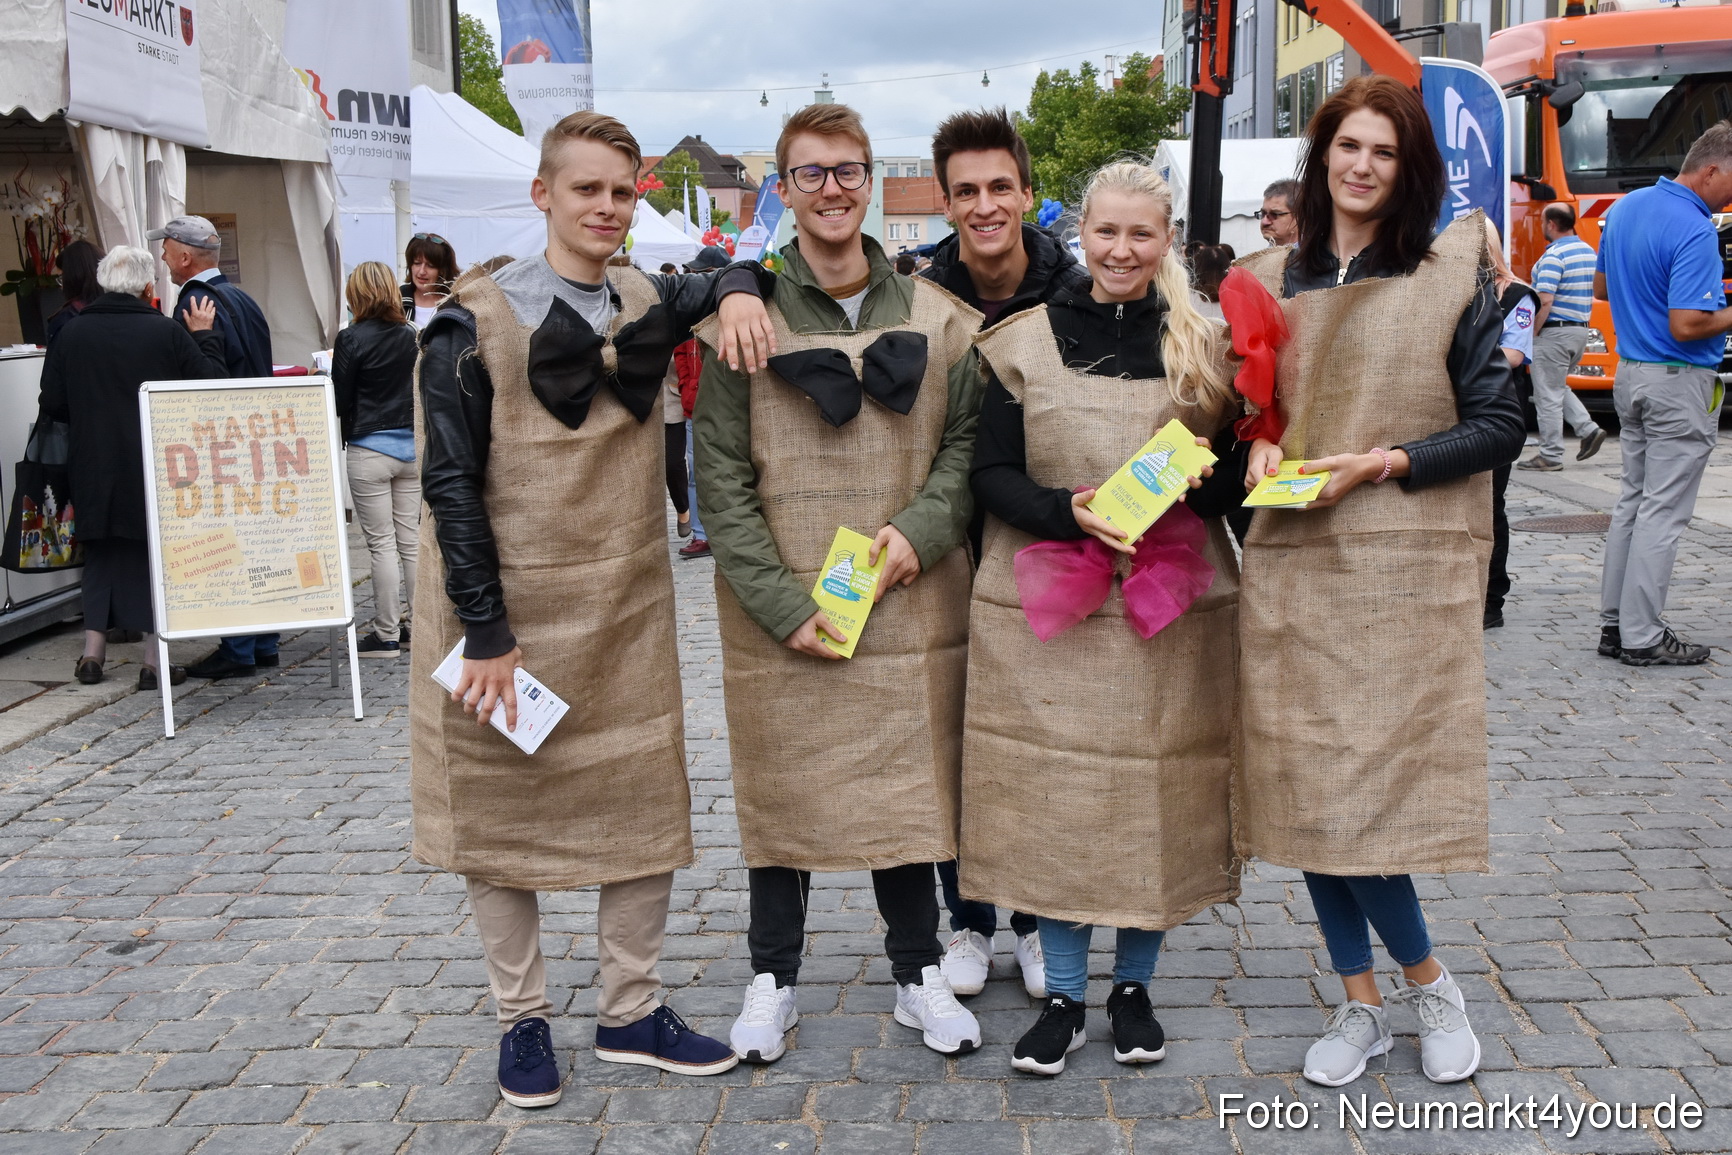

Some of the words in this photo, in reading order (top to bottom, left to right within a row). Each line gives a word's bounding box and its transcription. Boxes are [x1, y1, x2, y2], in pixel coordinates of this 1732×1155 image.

[138, 42, 160, 60] STARKE
[162, 50, 179, 66] STADT
[195, 395, 221, 405] Sport
[224, 394, 253, 404] Chirurg
[257, 392, 283, 403] Erfolg
[232, 404, 260, 413] Bildung
[266, 401, 300, 409] Soziales
[151, 415, 189, 423] Zauberer
[179, 424, 215, 433] Tauchen
[152, 435, 186, 443] Studium
[164, 437, 310, 489] DEIN
[286, 477, 329, 485] Feuerwehr
[174, 480, 300, 518] DING
[262, 488, 295, 499] Leistung
[184, 501, 228, 513] Erfahrung
[202, 511, 239, 519] Vertrieb
[246, 507, 291, 517] Wirtschaft
[298, 505, 332, 515] Metzger
[234, 517, 284, 529] Bauchgefühl
[289, 514, 332, 523] Ehrlichkeit
[236, 526, 304, 539] Dienstleistungen
[308, 524, 333, 532] Stadt
[173, 545, 191, 554] Save
[207, 533, 225, 543] date
[244, 536, 286, 546] Techniker
[293, 533, 335, 543] Gestalten
[290, 543, 336, 553] Expedition
[170, 561, 182, 569] 23.
[184, 555, 202, 564] Juni,
[203, 543, 237, 558] Jobmeile
[183, 559, 234, 579] Rathausplatz
[247, 565, 272, 574] THEMA
[264, 569, 293, 579] MONATS
[251, 581, 266, 589] JUNI
[194, 590, 221, 599] Politik
[305, 592, 340, 600] Zuhause
[819, 606, 837, 617] RISCHER
